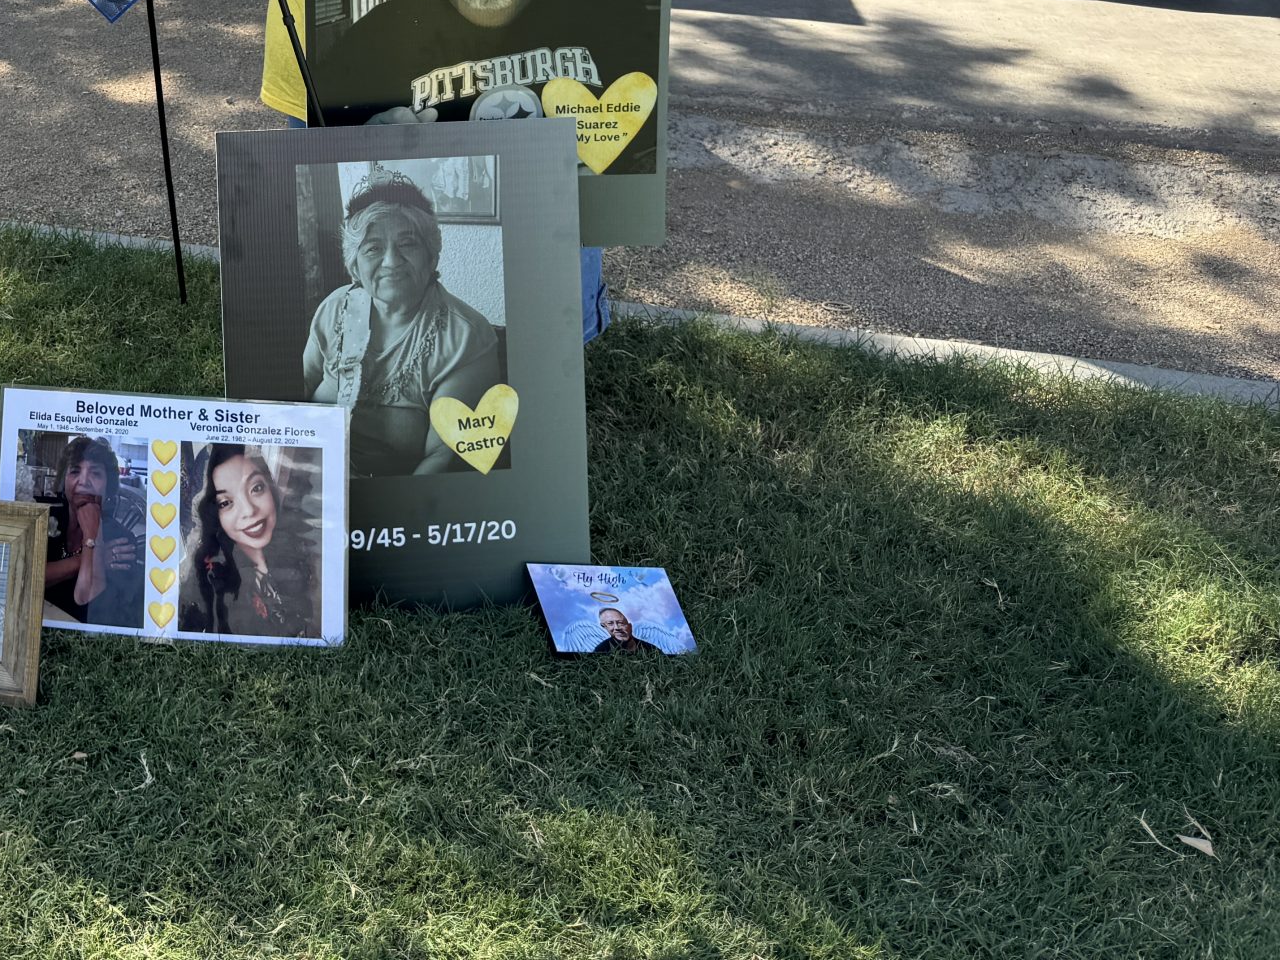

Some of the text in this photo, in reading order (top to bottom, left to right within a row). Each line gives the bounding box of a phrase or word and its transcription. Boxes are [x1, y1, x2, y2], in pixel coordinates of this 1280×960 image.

[411, 46, 604, 114] PITTSBURGH
[555, 102, 641, 116] Michael Eddie
[577, 120, 618, 130] Suarez
[594, 132, 620, 142] Love
[29, 411, 139, 428] Elida Esquivel Gonzalez
[76, 399, 261, 426] Beloved Mother & Sister
[75, 425, 104, 433] September
[190, 422, 316, 437] Veronica Gonzalez Flores
[457, 413, 496, 435] Mary
[455, 434, 506, 455] Castro
[344, 527, 406, 551] 9/45
[426, 520, 516, 546] 5/17/20
[573, 572, 627, 588] Fly High
